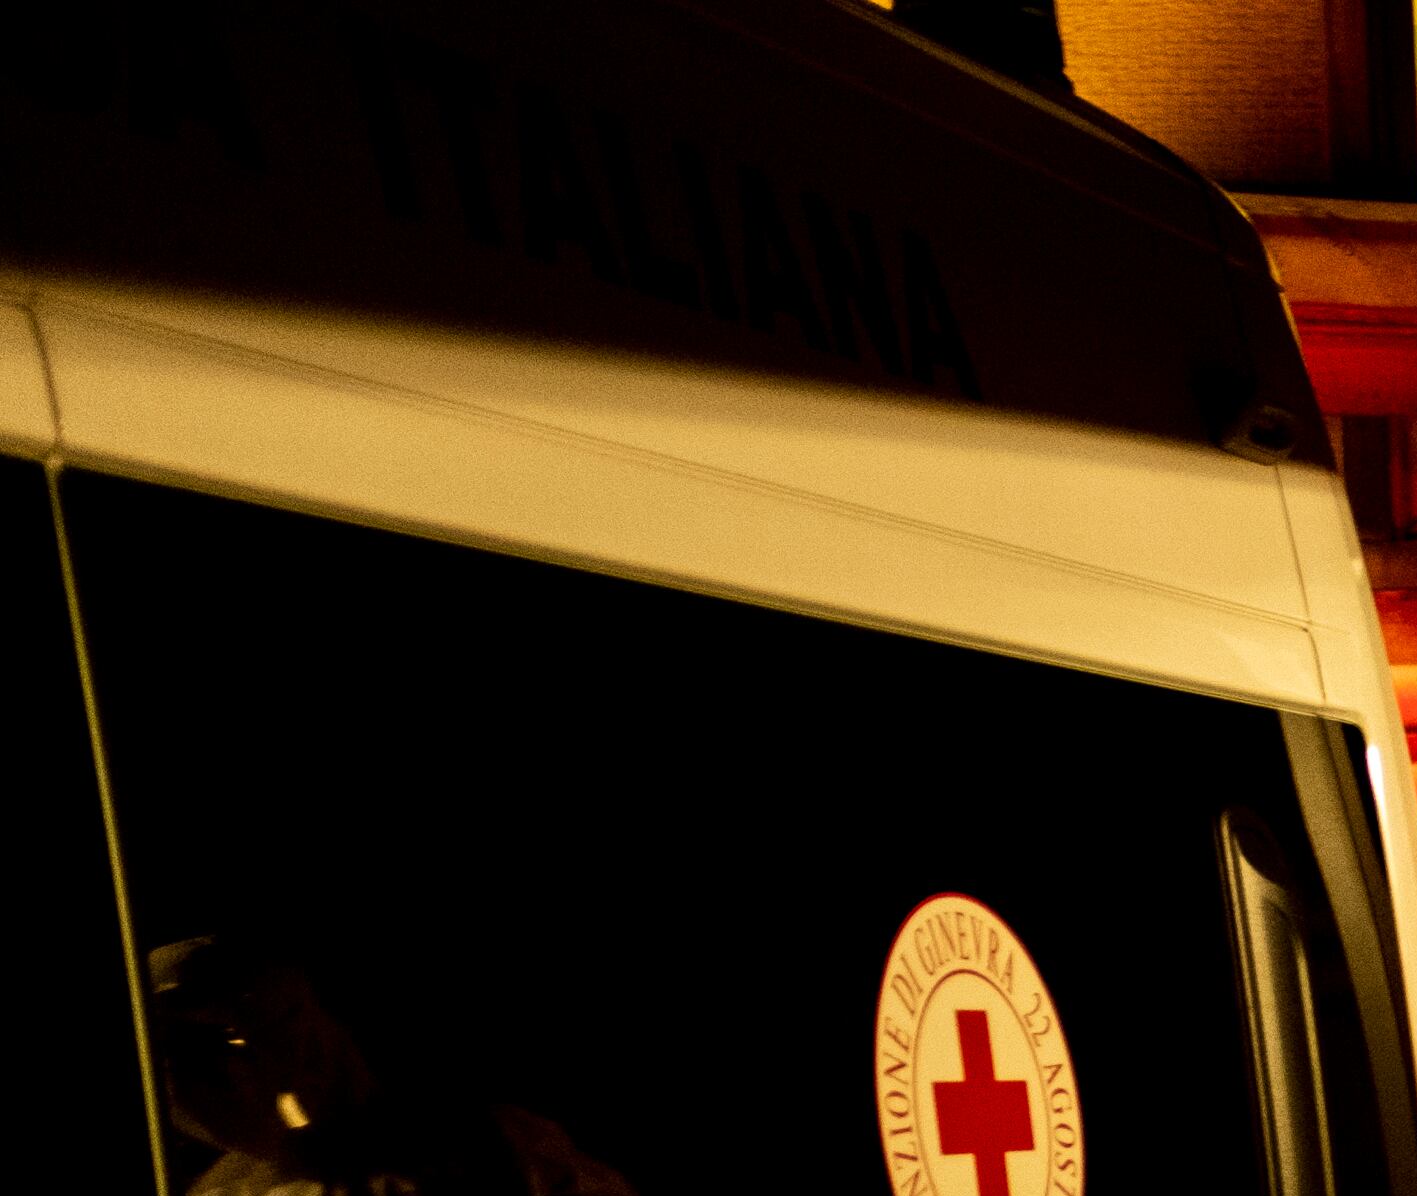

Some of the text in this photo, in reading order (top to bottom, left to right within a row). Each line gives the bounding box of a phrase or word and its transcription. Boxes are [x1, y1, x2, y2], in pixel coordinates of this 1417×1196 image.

[332, 10, 982, 402] ITALIANA
[890, 952, 925, 1017] DI
[913, 910, 1016, 994] GINEVRA
[1023, 991, 1052, 1048] 22
